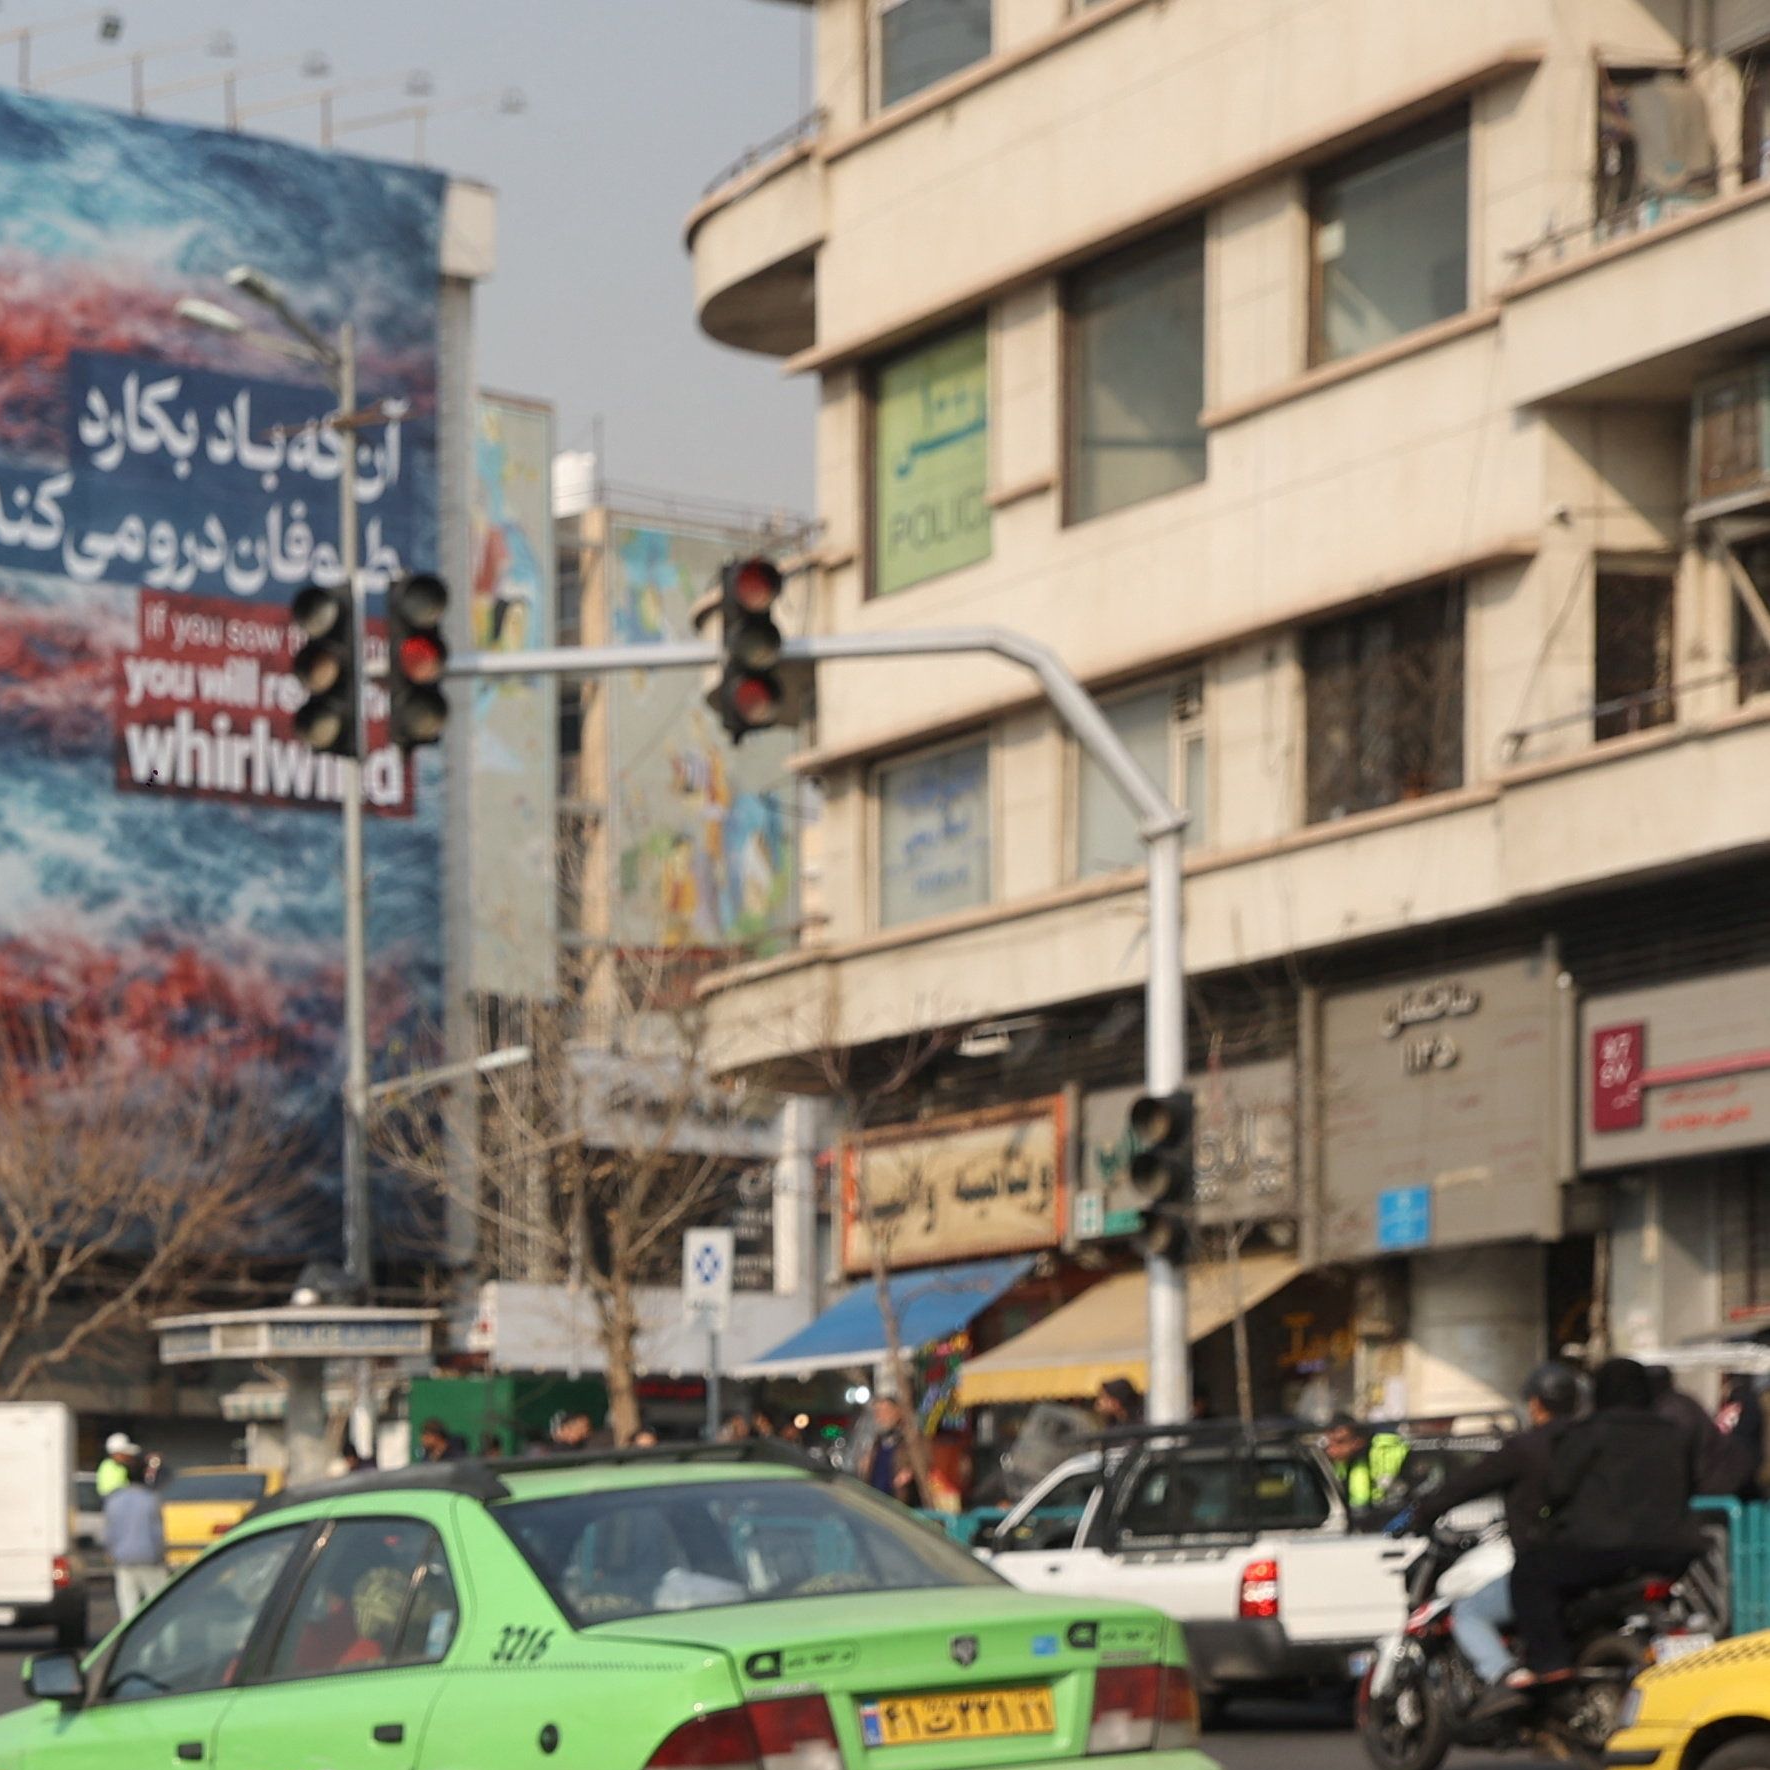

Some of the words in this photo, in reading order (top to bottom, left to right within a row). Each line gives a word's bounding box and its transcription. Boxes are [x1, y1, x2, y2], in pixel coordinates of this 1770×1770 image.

[78, 370, 200, 480] بکارد
[206, 388, 286, 491] باد
[223, 499, 402, 596] طوفان
[145, 600, 168, 641] If
[171, 613, 223, 651] you
[225, 618, 283, 651] sow
[124, 657, 195, 708] you
[197, 657, 260, 709] will
